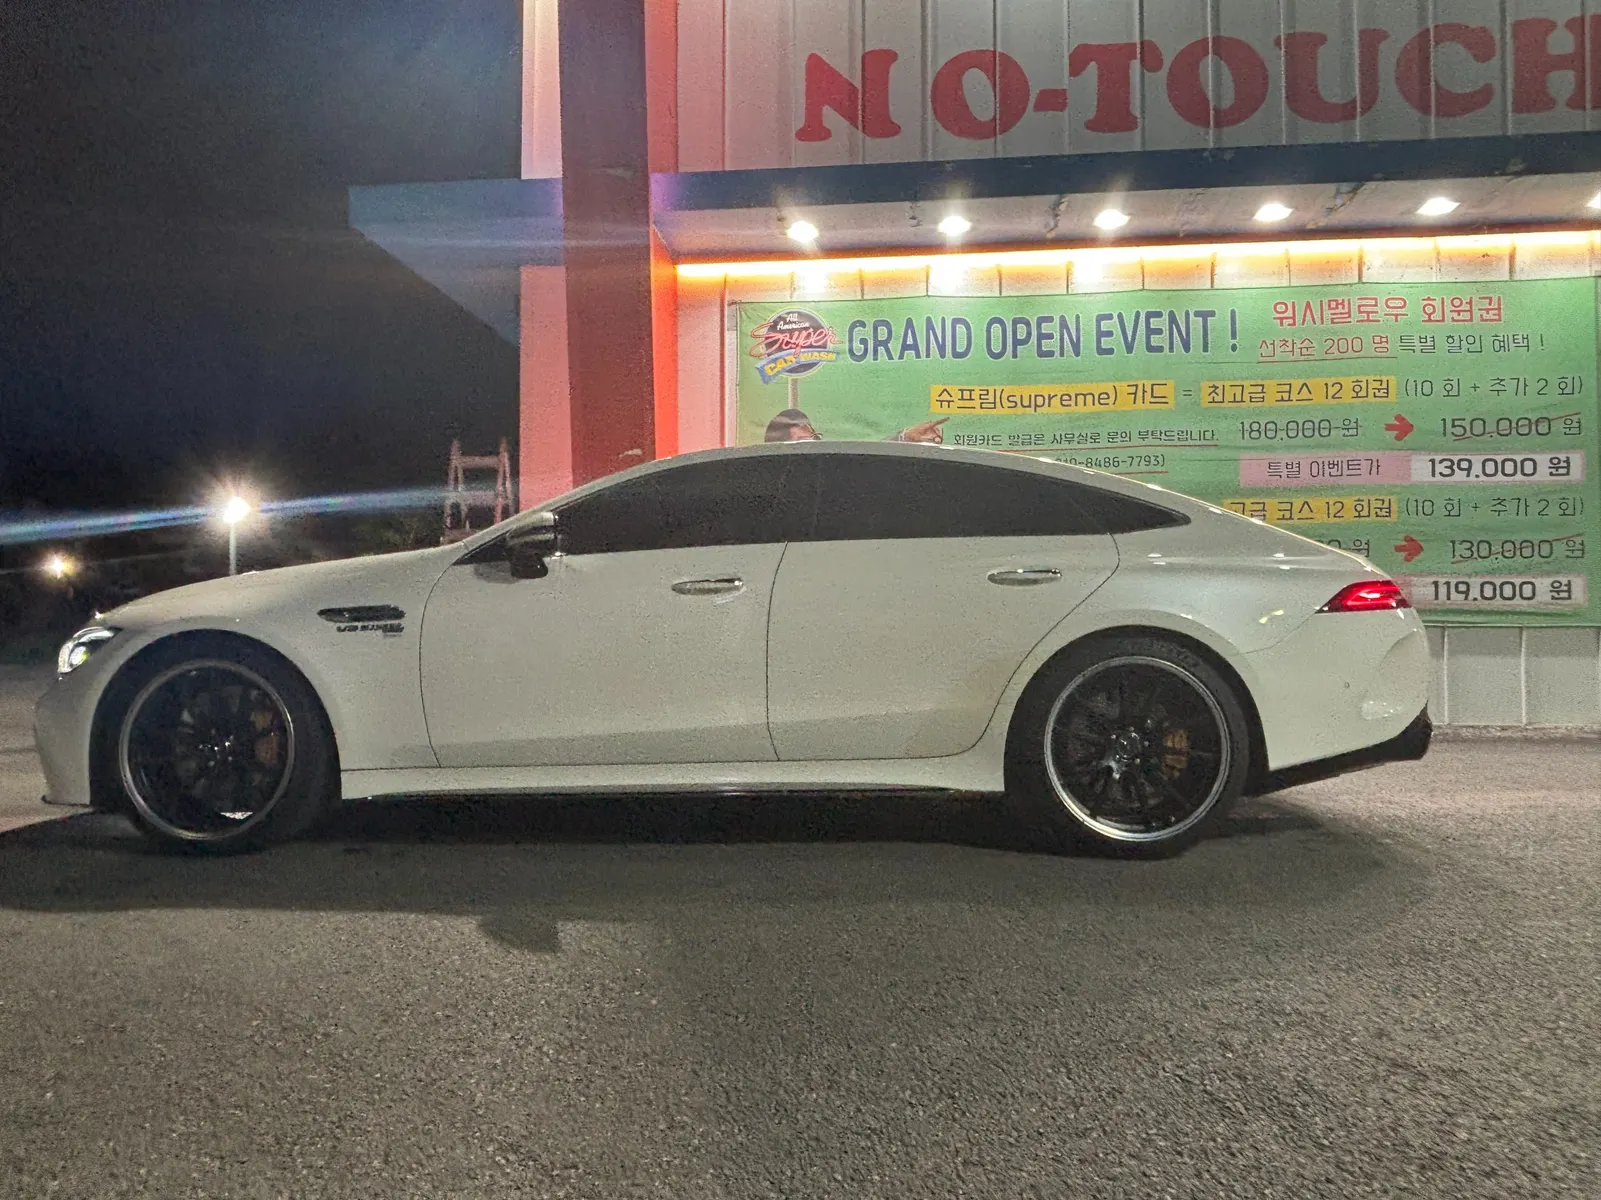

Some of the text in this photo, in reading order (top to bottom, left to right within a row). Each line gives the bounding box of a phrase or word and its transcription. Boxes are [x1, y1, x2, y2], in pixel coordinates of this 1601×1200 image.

[795, 14, 1601, 142] NO-TOUCH
[787, 313, 799, 322] All
[1272, 295, 1503, 327] 워시멜로우 회원권
[777, 321, 810, 331] American
[847, 316, 972, 362] GRAND
[985, 314, 1080, 360] OPEN
[1095, 309, 1216, 356] EVENT
[1259, 337, 1316, 358] 선착순
[1324, 336, 1364, 355] 200
[1372, 334, 1390, 353] 명
[1398, 333, 1436, 353] 특별
[1445, 334, 1483, 353] 할인
[1491, 333, 1530, 353] 혜택
[764, 352, 837, 376] CAR WASH
[935, 385, 1118, 412] 슈프림(supreme)
[1127, 383, 1169, 405] 카드
[1207, 383, 1267, 404] 최고급
[1275, 382, 1314, 401] 코스
[1323, 382, 1344, 400] 12
[1351, 379, 1390, 399] 회권
[1405, 378, 1434, 397] (10
[1443, 378, 1461, 397] 회
[1489, 377, 1529, 397] 추가
[1536, 378, 1549, 396] 2
[1557, 376, 1583, 396] 회)
[954, 433, 1002, 446] 회원카드
[1008, 433, 1045, 446] 발급은
[1050, 431, 1101, 445] 사무실로
[1107, 430, 1132, 444] 문의
[1241, 416, 1582, 441] 180.000 원 150.000 원
[1267, 456, 1571, 478] 특별 이벤트가 139.000 원
[1276, 500, 1315, 520] 코스
[1325, 500, 1344, 518] 12
[1353, 498, 1392, 518] 회권
[1405, 498, 1435, 517] (10
[1444, 498, 1461, 517] 회
[1490, 497, 1530, 517] 추가
[1537, 499, 1549, 516] 2
[1558, 497, 1584, 516] 회)
[1450, 539, 1553, 560] 130.000
[1565, 539, 1585, 559] 원
[1432, 579, 1572, 602] 119.000 원
